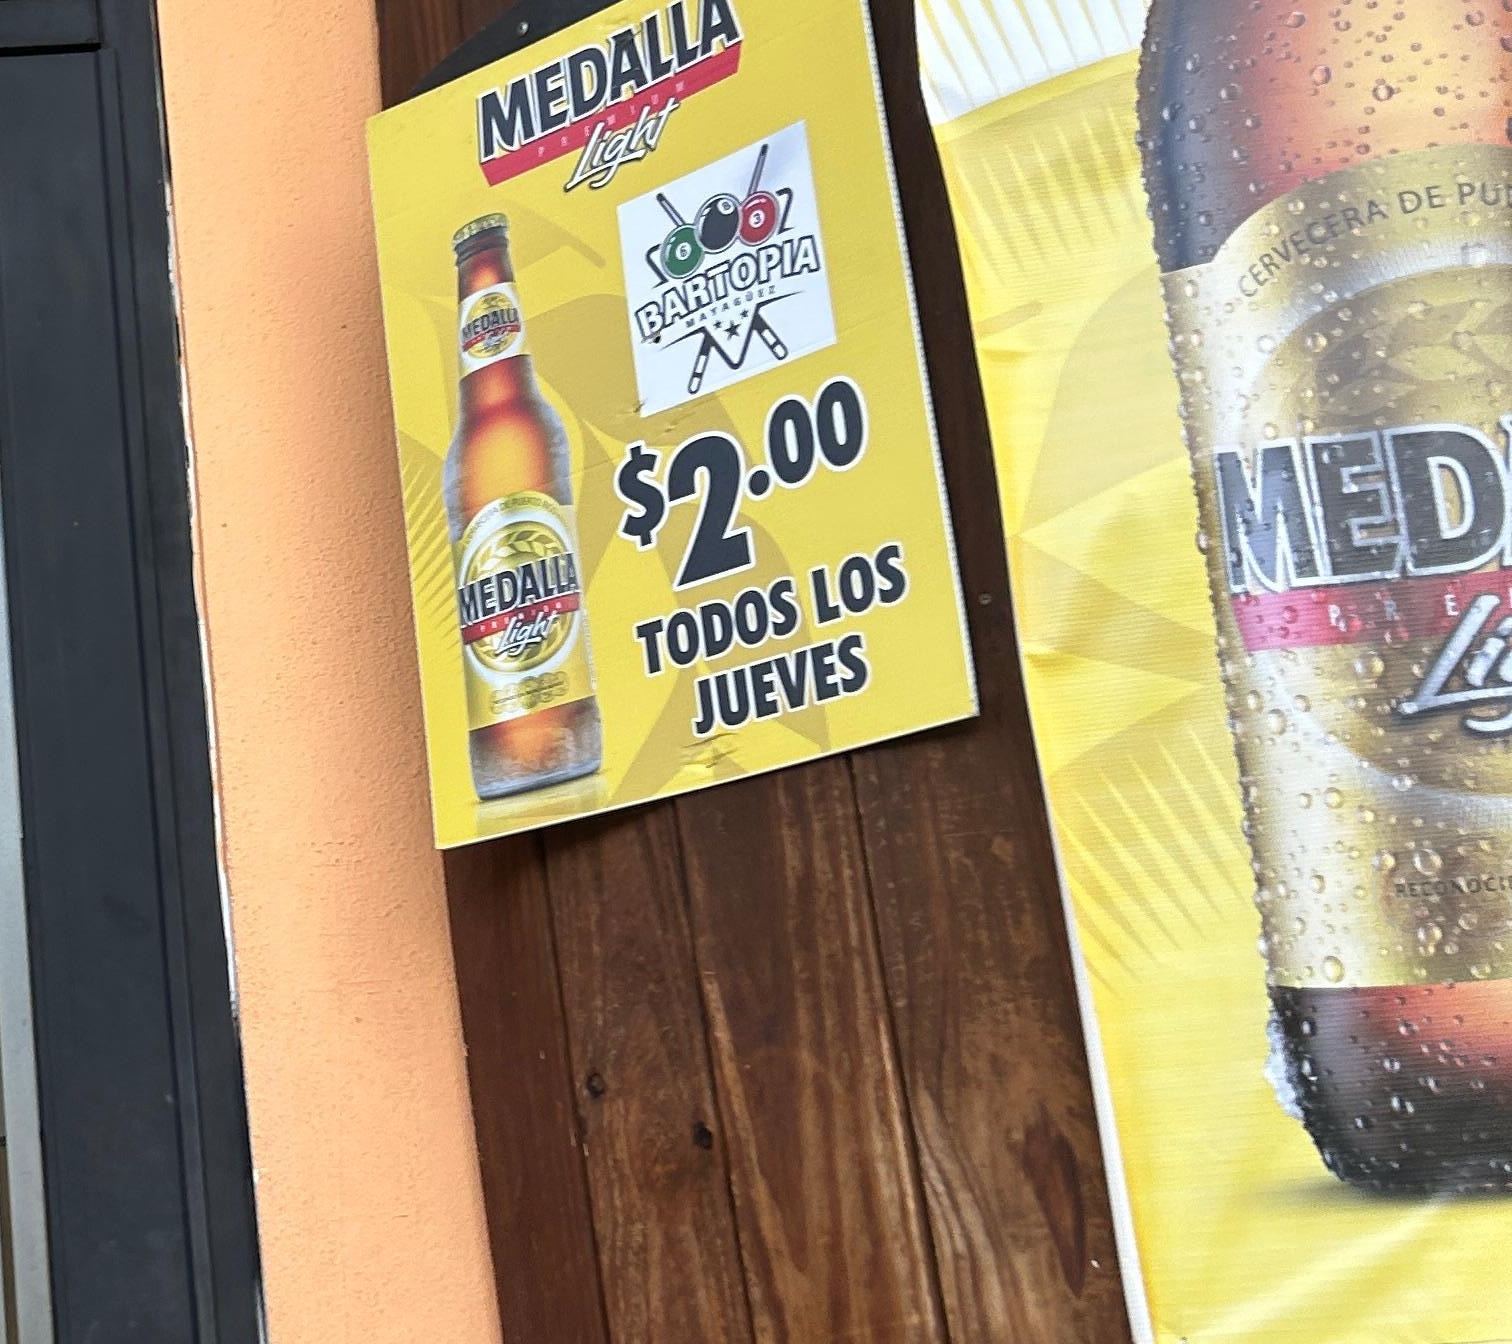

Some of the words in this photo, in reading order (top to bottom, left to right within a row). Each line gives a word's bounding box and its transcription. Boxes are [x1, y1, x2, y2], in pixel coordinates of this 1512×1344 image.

[563, 96, 681, 193] Light
[635, 235, 821, 340] BARTOPIA
[1238, 199, 1390, 297] CERVECERA
[1398, 185, 1447, 215] DE
[616, 377, 867, 591] $2.00
[458, 552, 581, 629] MEDALLA
[495, 611, 559, 656] Light
[636, 578, 801, 677] TODOS
[809, 542, 908, 625] LOS
[693, 634, 869, 736] JUEVES
